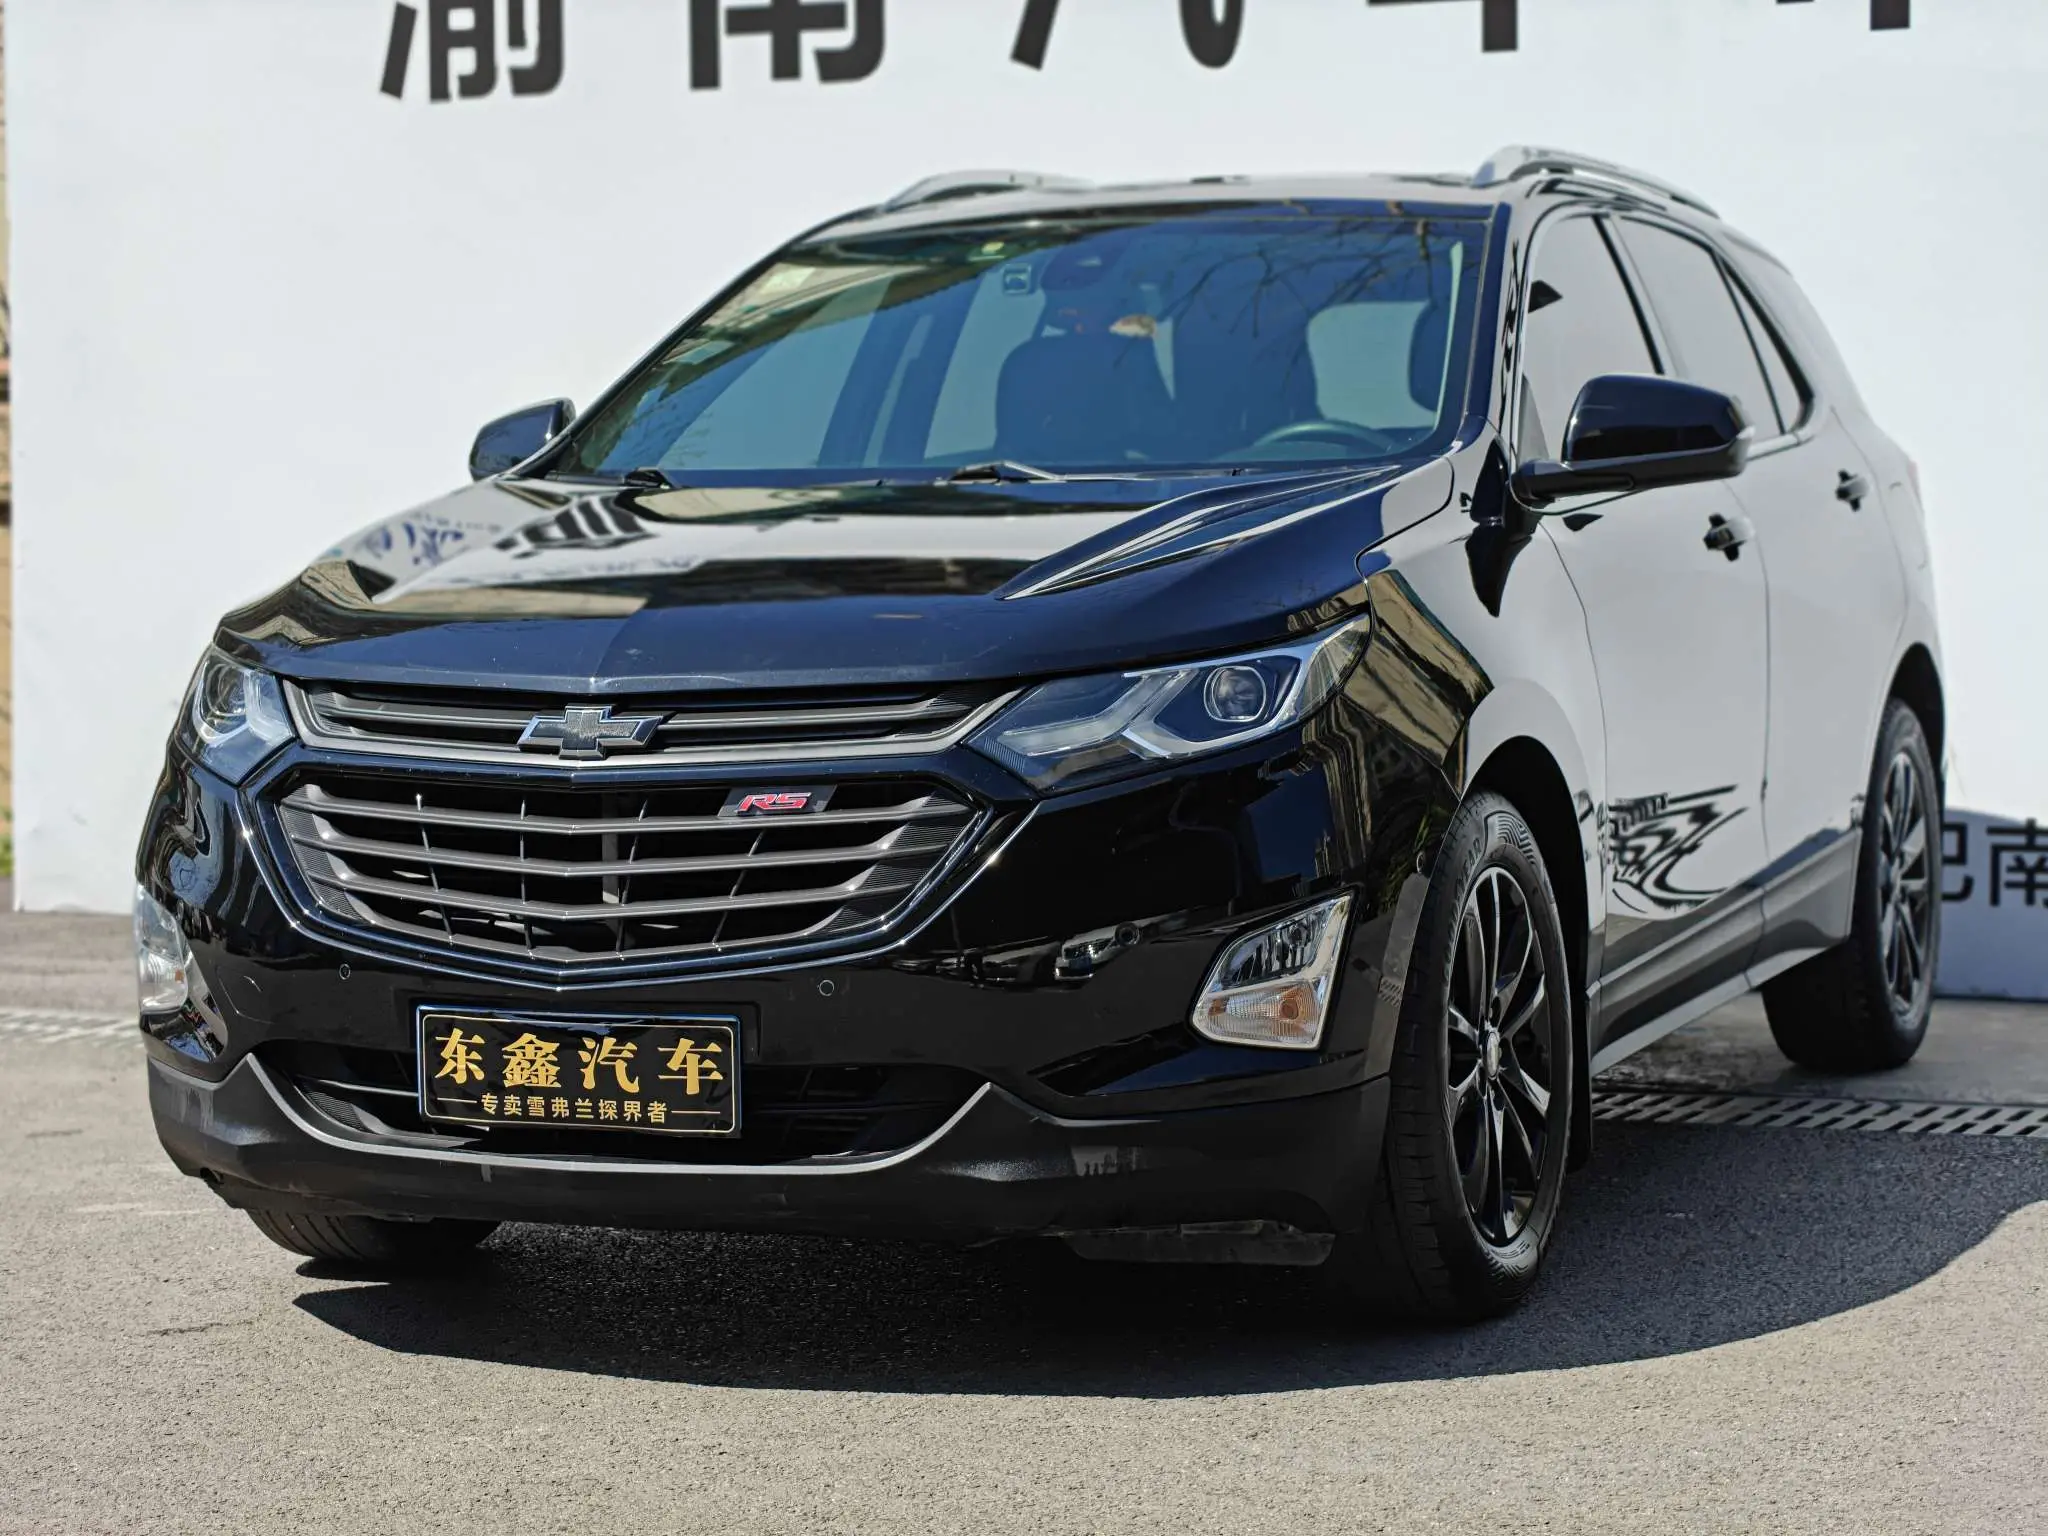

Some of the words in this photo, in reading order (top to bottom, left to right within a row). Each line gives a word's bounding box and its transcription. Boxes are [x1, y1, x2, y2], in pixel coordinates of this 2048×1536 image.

[736, 791, 812, 813] RS
[434, 1027, 723, 1095] 东鑫汽车
[480, 1093, 667, 1124] 专卖雪弗兰探界者
